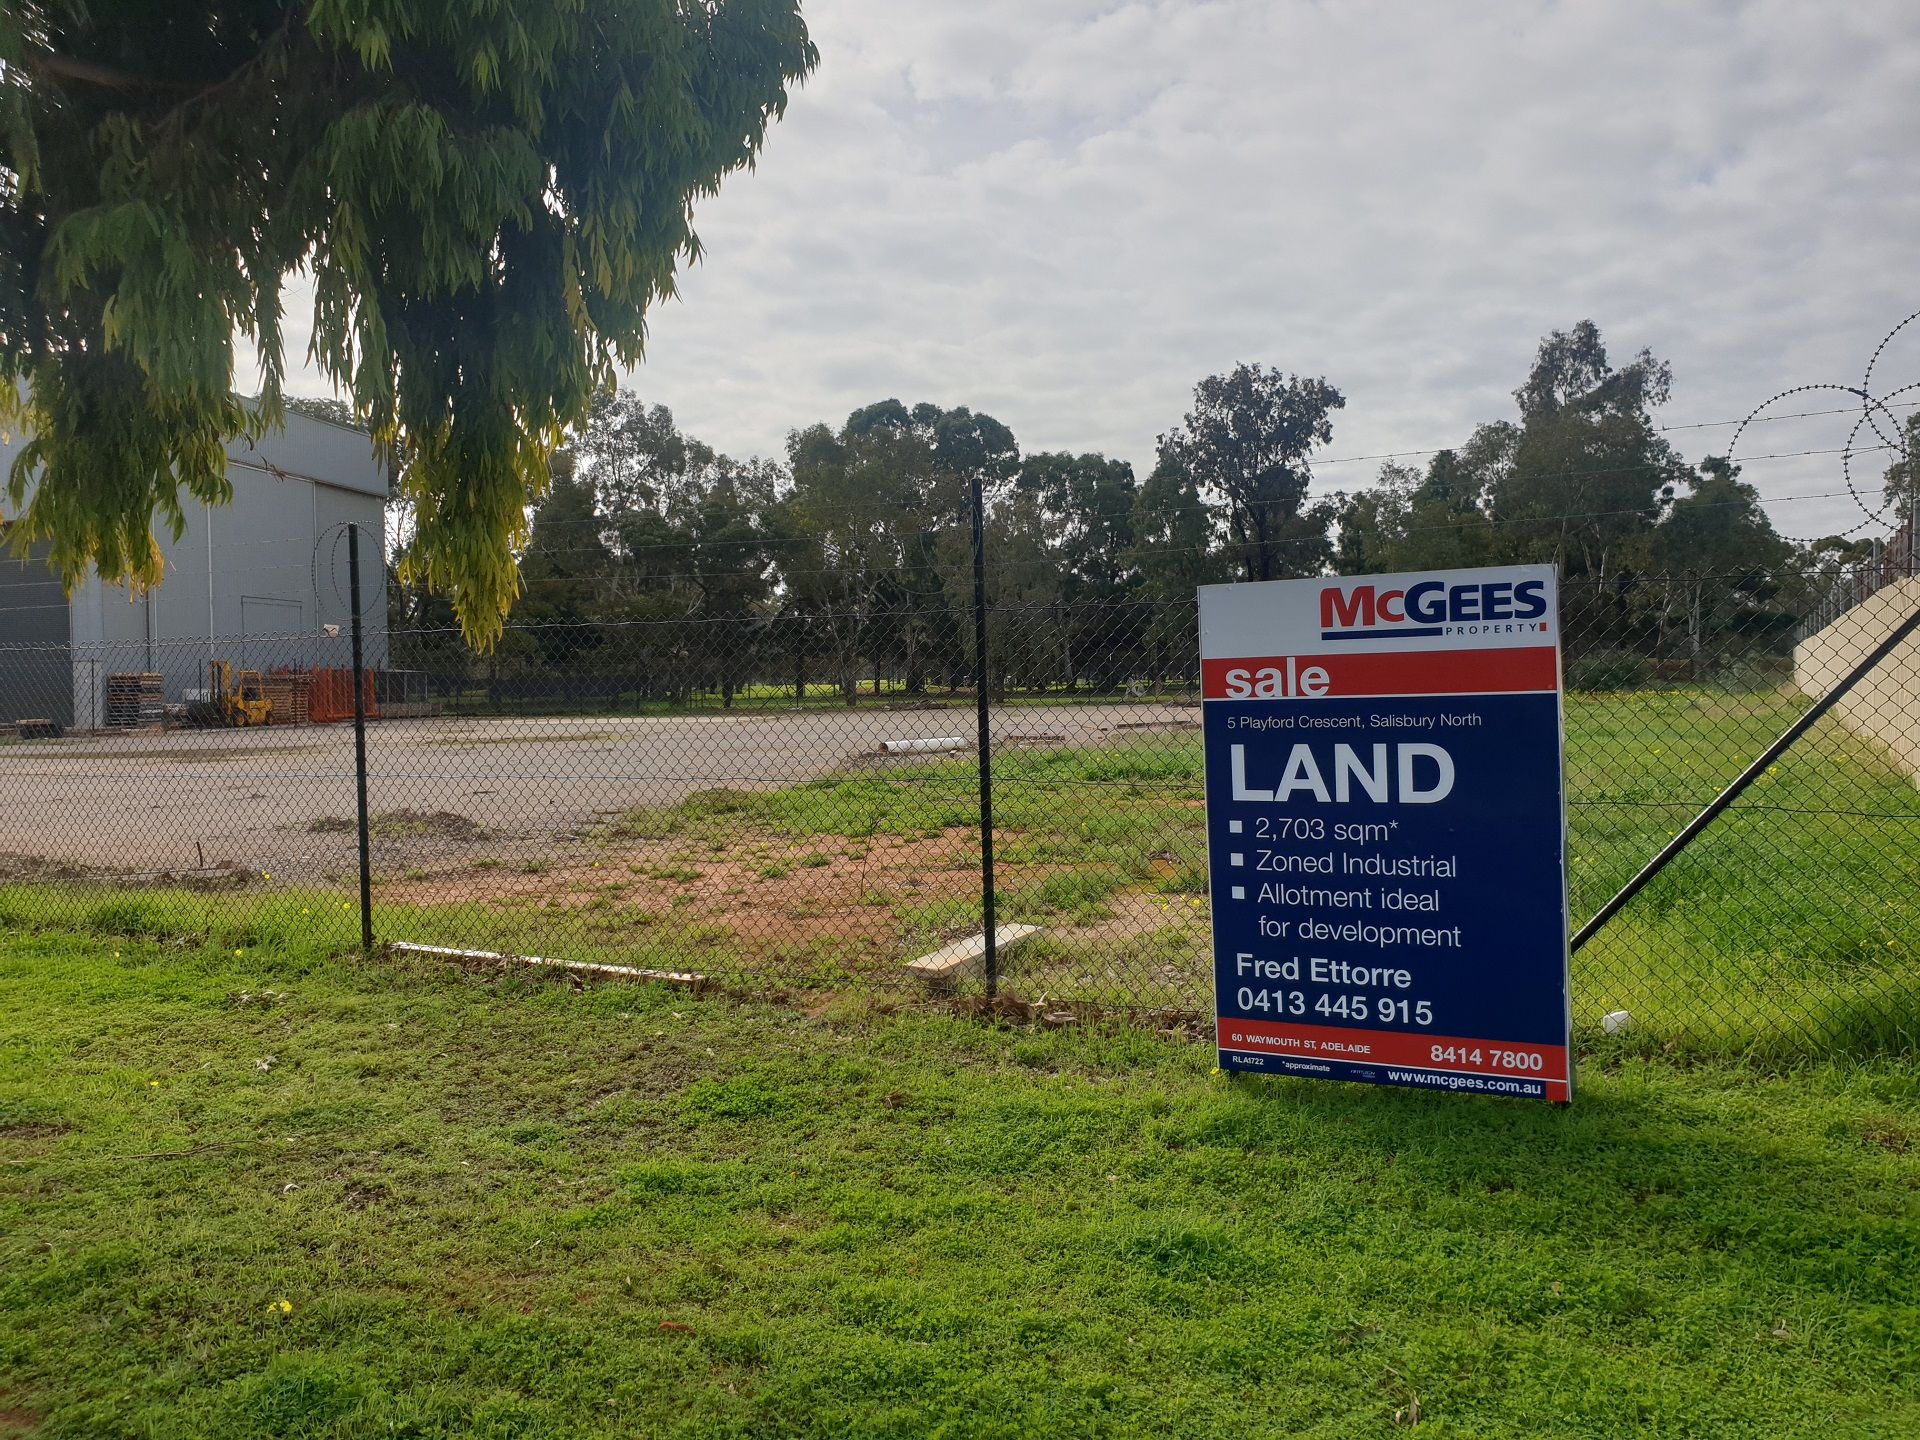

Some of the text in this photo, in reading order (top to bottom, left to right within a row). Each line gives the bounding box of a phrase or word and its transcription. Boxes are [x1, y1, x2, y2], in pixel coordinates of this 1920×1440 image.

[1446, 623, 1537, 636] PROPERTY
[1225, 656, 1330, 698] sale
[1227, 712, 1482, 731] 5 Playford Crescent, Salisbury North
[1230, 742, 1455, 804] LAND
[1255, 817, 1325, 841] 2,703
[1255, 850, 1457, 878] Zoned Industrial
[1257, 883, 1439, 912] Allotment ideal
[1259, 915, 1462, 948] for development
[1236, 952, 1412, 988] Fred Ettorre
[1237, 986, 1433, 1025] 0413 445 915
[1231, 1033, 1243, 1042] 60
[1246, 1034, 1300, 1048] WAYMOUTH
[1320, 1042, 1371, 1054] ADELAIDE
[1430, 1044, 1543, 1071] 8414 7800
[1387, 1068, 1541, 1095] www.mcgees.com.au
